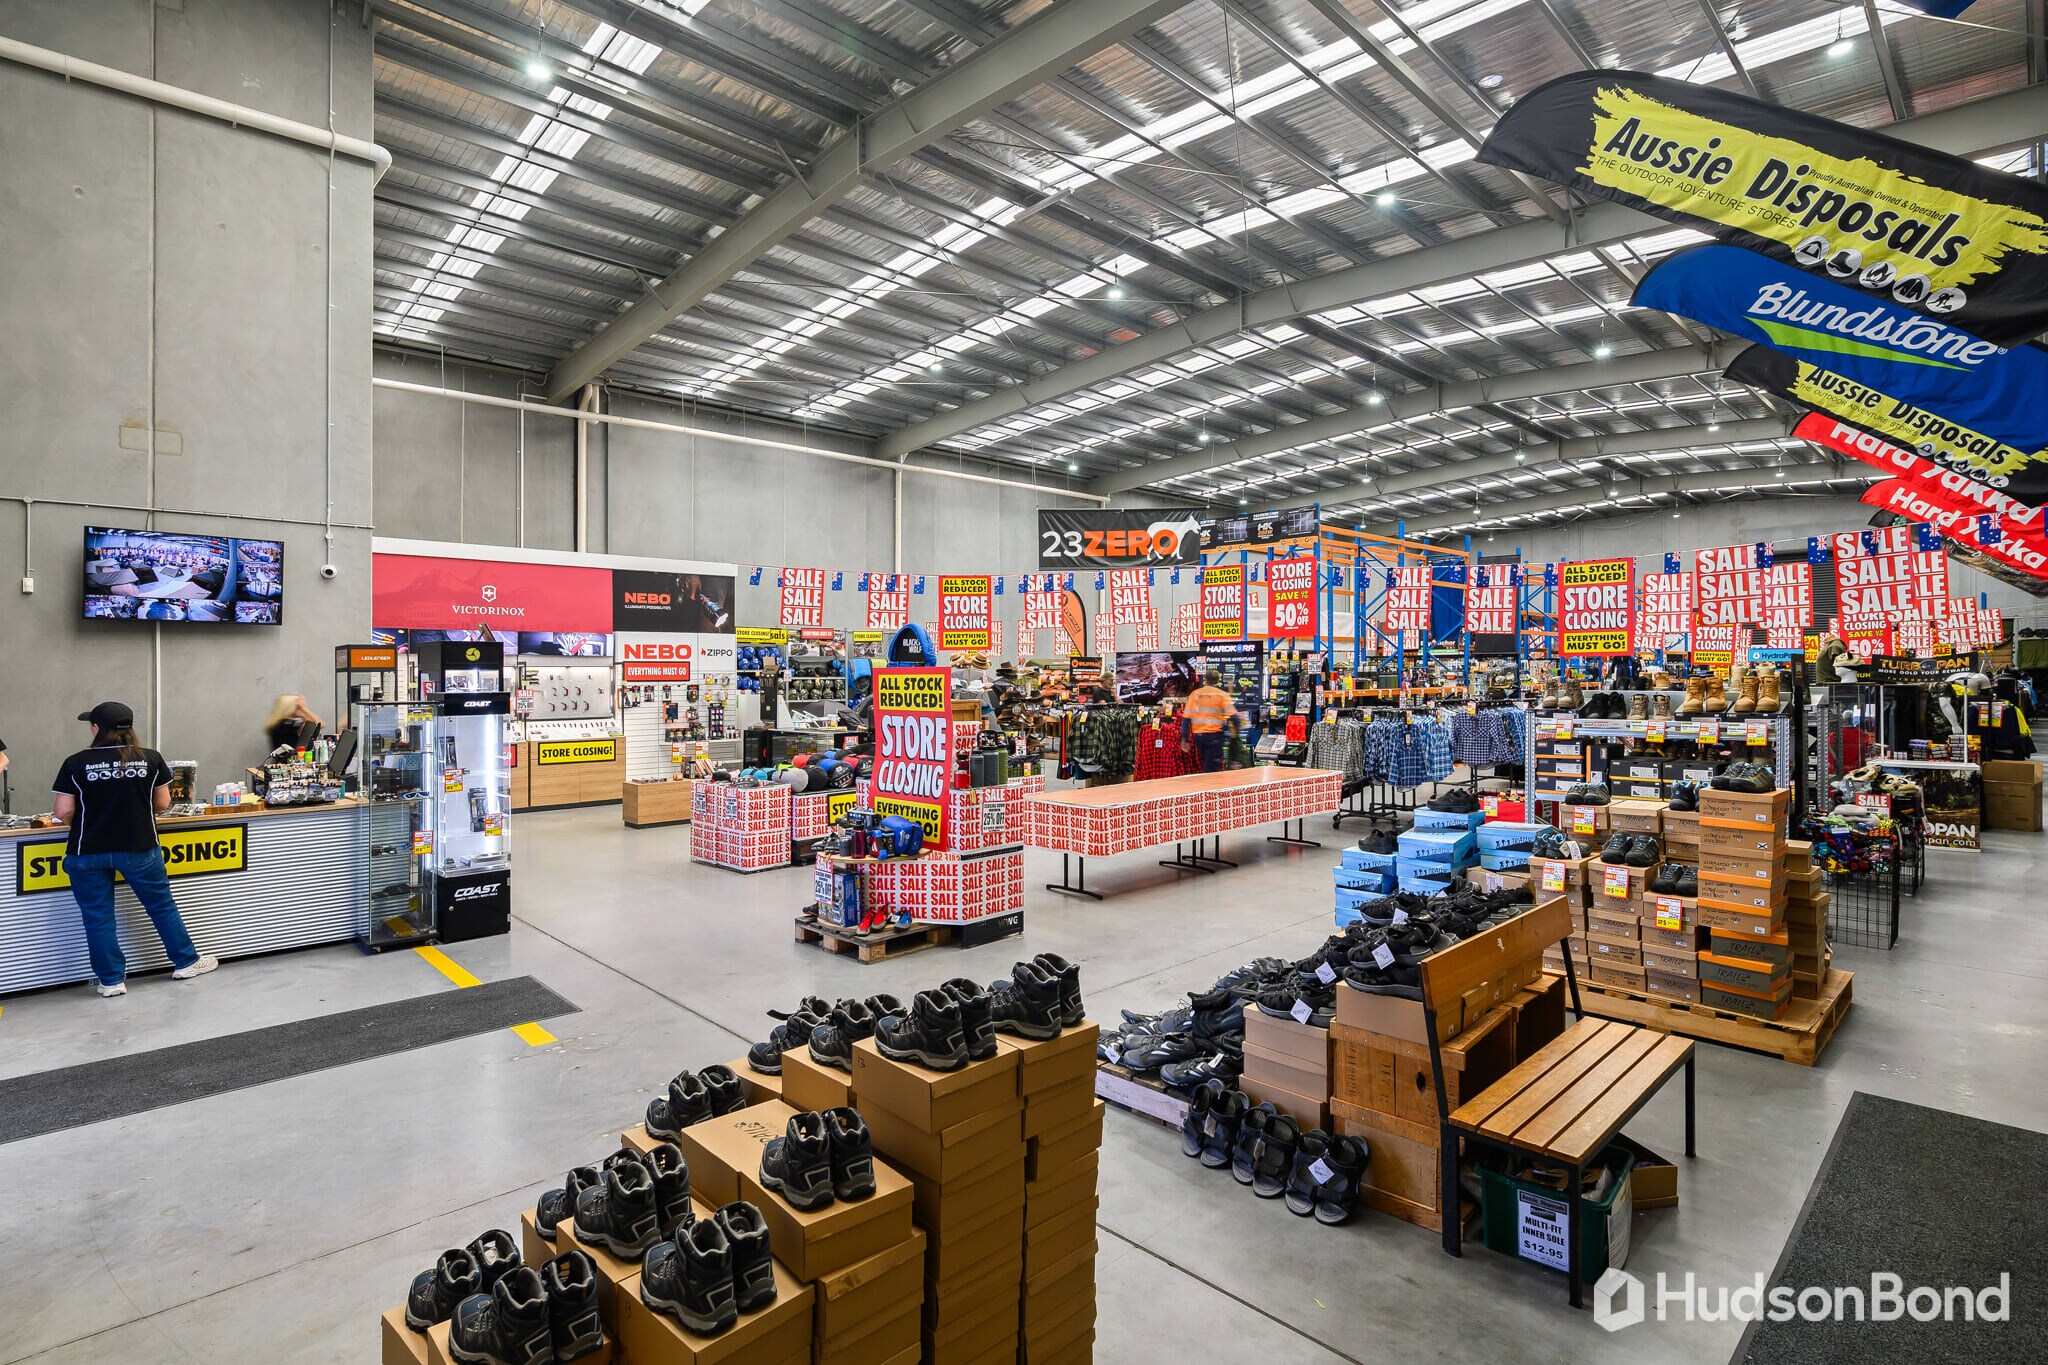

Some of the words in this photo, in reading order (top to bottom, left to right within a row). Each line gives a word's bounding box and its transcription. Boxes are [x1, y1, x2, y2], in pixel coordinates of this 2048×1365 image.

[1596, 156, 1615, 170] THE
[1619, 163, 1673, 187] OUTDOOR
[1675, 181, 1746, 211] ADVENTURE
[1747, 205, 1798, 229] STORES
[1603, 116, 1734, 186] Aussie
[1744, 157, 1971, 267] Disposals
[1807, 169, 1837, 185] Proudly
[1836, 177, 1874, 198] Australian
[1874, 190, 1902, 206] Owned
[1909, 202, 1946, 222] Operated
[1804, 366, 1882, 409] Aussie
[1888, 400, 2011, 465] Disposals
[1848, 403, 1890, 425] ADVENTURE
[1890, 421, 1919, 438] STORES
[1889, 486, 1963, 528] Hard
[1041, 529, 1179, 557] 23ZERO
[1271, 561, 1312, 579] STORE
[1565, 567, 1585, 575] ALL
[1589, 563, 1626, 573] STOCK
[1838, 555, 1911, 587] SALE
[784, 568, 823, 588] SALE
[1111, 570, 1147, 588] SALE
[1205, 575, 1241, 584] REDUCED!
[1272, 578, 1312, 591] CLOSING
[1565, 572, 1626, 584] REDUCED!
[1646, 573, 1690, 593] SALE
[1700, 572, 1762, 599] SALE
[624, 592, 671, 605] NEBO
[783, 588, 822, 606] SALE
[870, 592, 907, 611] SALE
[1026, 593, 1062, 610] SALE
[1113, 588, 1148, 606] SALE
[1204, 585, 1241, 605] STORE
[1275, 591, 1299, 601] SAVE
[1389, 589, 1429, 608] SALE
[1468, 589, 1513, 609] SALE
[1564, 585, 1628, 611] STORE
[1645, 594, 1690, 613] SALE
[1841, 584, 1914, 615] SALE
[452, 605, 525, 616] VICTORINOX
[943, 595, 988, 615] STORE
[1204, 604, 1241, 620] CLOSING
[1702, 598, 1764, 625] SALE
[782, 607, 821, 626] SALE
[869, 611, 906, 629] SALE
[943, 615, 988, 630] CLOSING
[1026, 611, 1063, 629] SALE
[1114, 606, 1149, 625] SALE
[1297, 615, 1309, 625] OFF
[1388, 611, 1428, 630] SALE
[1468, 611, 1512, 632] SALE
[1564, 610, 1628, 630] CLOSING
[1645, 614, 1690, 633] SALE
[1095, 627, 1115, 640] SALE
[1138, 623, 1158, 636] SALE
[1696, 626, 1733, 640] STORE
[1844, 621, 1887, 631] CLOSING
[1900, 627, 1929, 637] SALE
[1018, 632, 1035, 644] SALE
[1138, 638, 1158, 651] SALE
[1566, 634, 1625, 642] EVERYTHING
[1634, 636, 1662, 649] SALE
[1695, 640, 1733, 650] CLOSING
[1900, 638, 1929, 649] SALE
[1938, 628, 1979, 645] SALE
[624, 644, 692, 659] NEBO
[707, 649, 733, 657] ZIPPO
[1018, 645, 1035, 656] SALE
[1096, 640, 1115, 654] SALE
[1567, 642, 1599, 651] MUST
[1603, 641, 1626, 649] GO!
[628, 667, 661, 676] EVERYTHING
[663, 667, 677, 676] MUST
[678, 667, 687, 675] GO
[881, 678, 900, 691] ALL
[904, 677, 943, 691] STOCK
[880, 693, 943, 709] REDUCED!
[882, 714, 947, 762] STORE
[542, 746, 570, 758] STORE
[573, 745, 613, 757] CLOSING!
[85, 761, 110, 770] Aussie
[877, 760, 945, 799] CLOSING
[985, 788, 1005, 801] SALE
[1858, 794, 1888, 807] SALE
[877, 801, 939, 820] EVERYTHING
[1090, 808, 1108, 819] SALE
[1088, 843, 1110, 856] SALE
[869, 863, 896, 877] SALE
[900, 863, 927, 877] SALE
[931, 864, 958, 877] SALE
[962, 862, 983, 877] SALE
[985, 856, 1006, 874] SALE
[454, 882, 502, 898] COAST
[1524, 1216, 1562, 1234] MULTI-FIT
[1522, 1226, 1545, 1240] INNER
[1546, 1233, 1565, 1246] SOLE
[1524, 1240, 1563, 1259] $12.95
